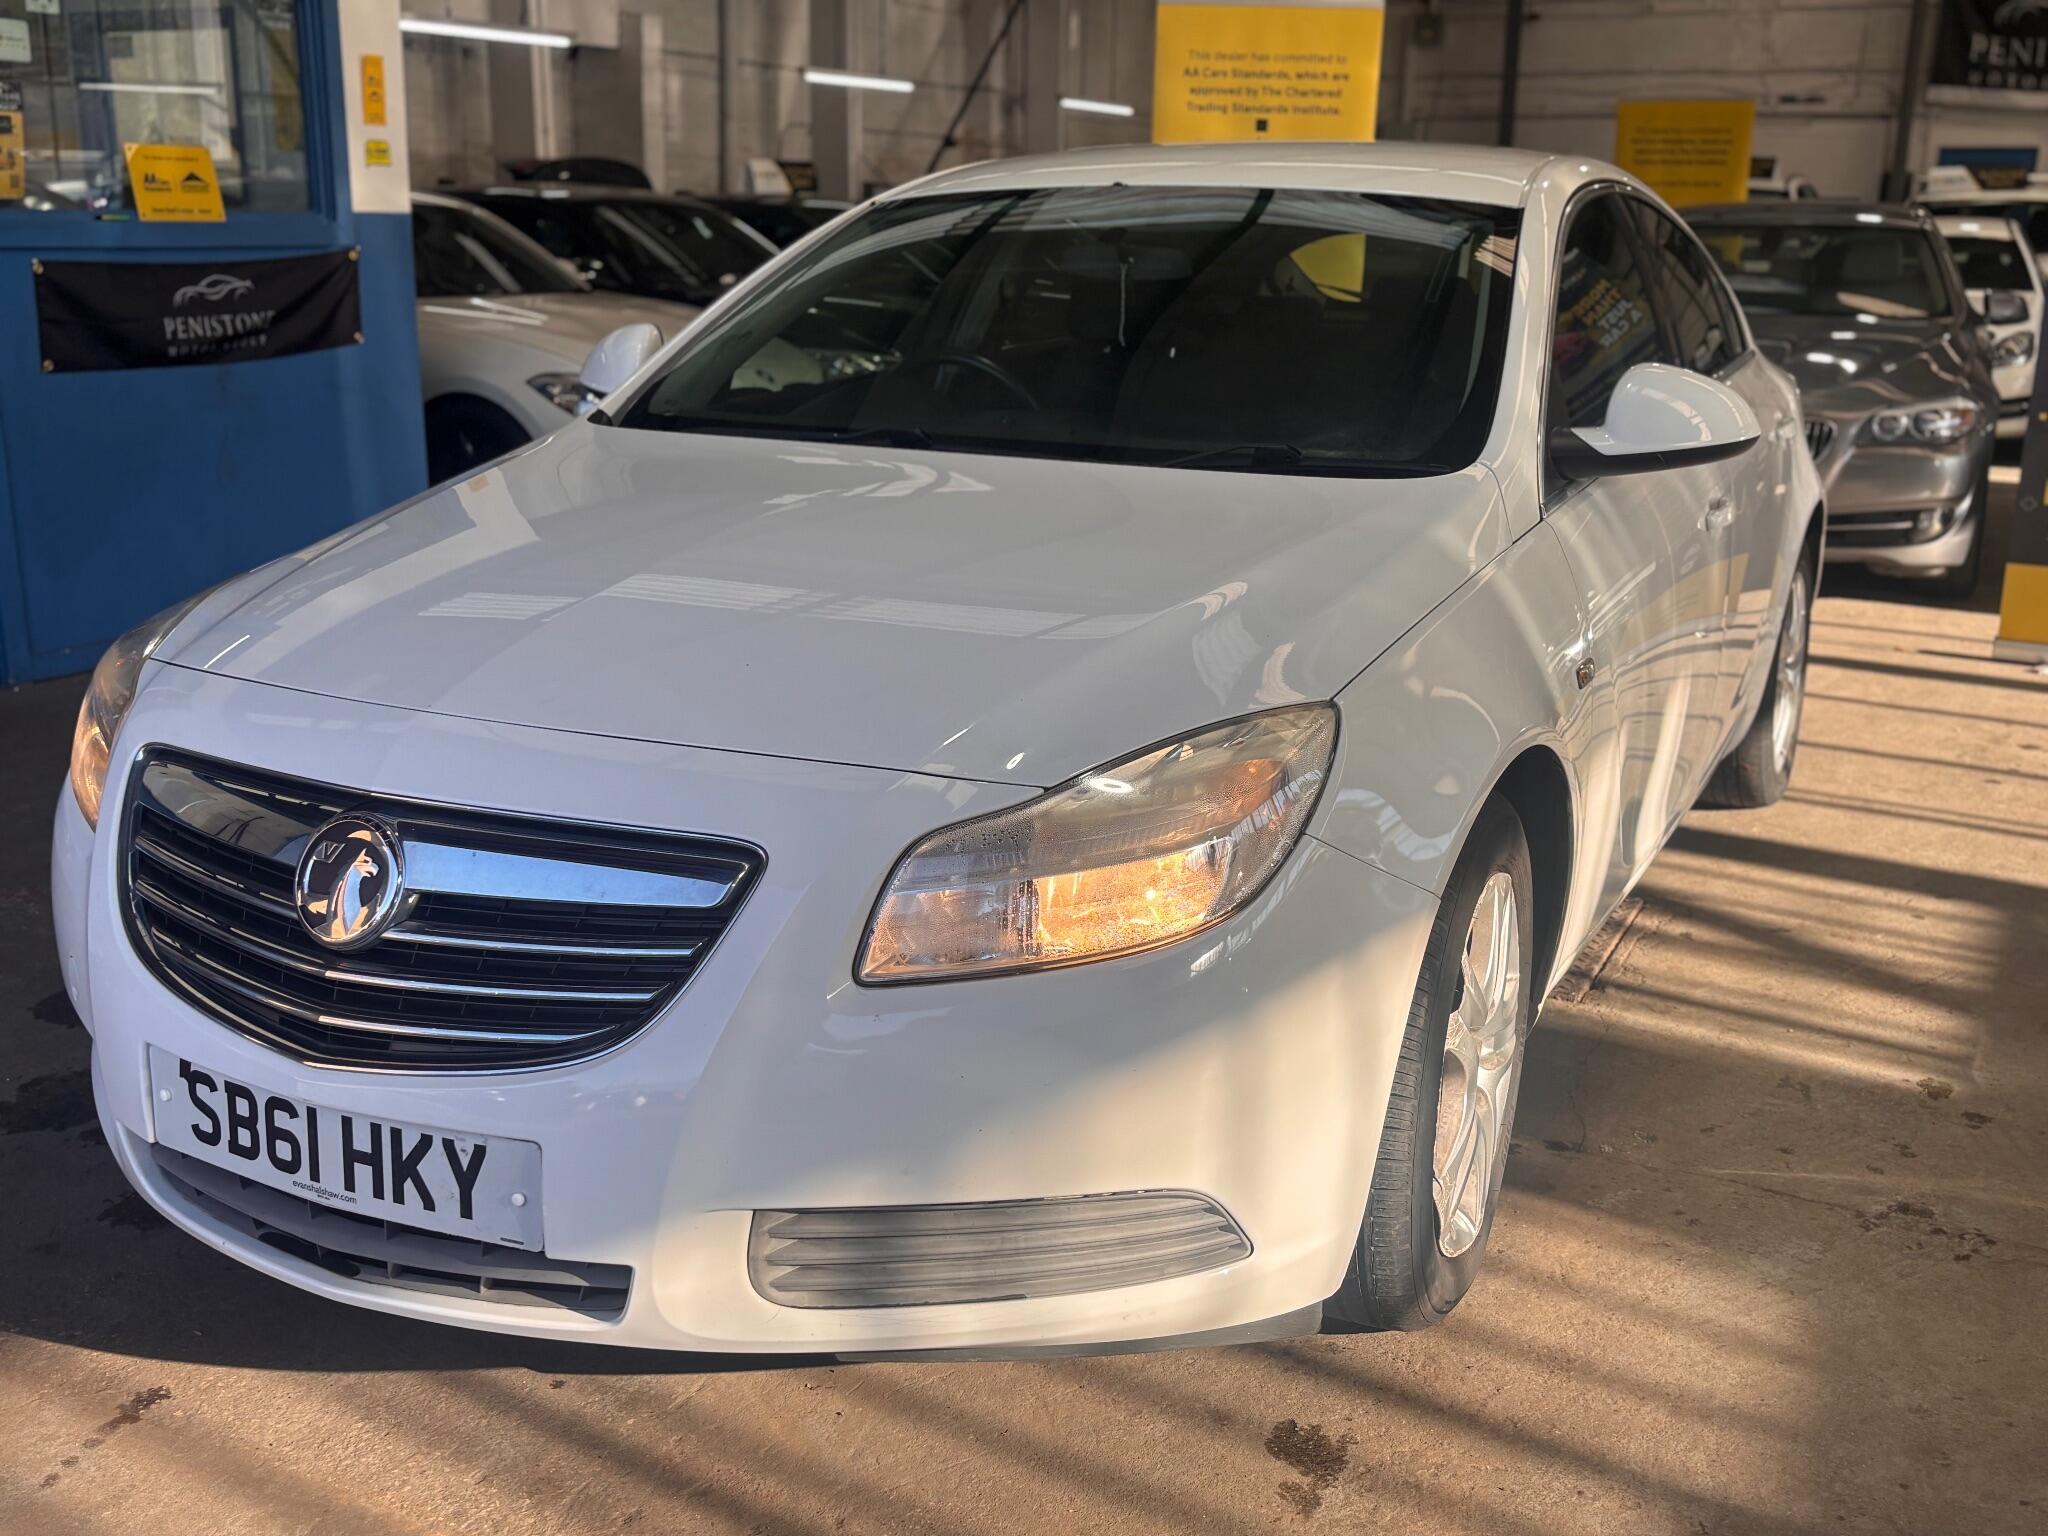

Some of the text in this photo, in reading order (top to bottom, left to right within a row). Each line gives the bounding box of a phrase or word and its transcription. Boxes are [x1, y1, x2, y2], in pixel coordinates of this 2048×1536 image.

[1214, 51, 1248, 61] dealer
[1252, 52, 1270, 62] has
[1274, 54, 1333, 64] committed
[1337, 55, 1347, 65] to
[1184, 67, 1199, 77] AA
[1296, 70, 1328, 81] which
[1333, 73, 1349, 82] are
[1189, 87, 1342, 99] approved by The Chartered
[1187, 102, 1228, 115] Trading
[1231, 102, 1289, 114] Standards
[186, 1069, 487, 1220] SB61 HKY
[292, 1180, 357, 1205] evanshalshaw.com
